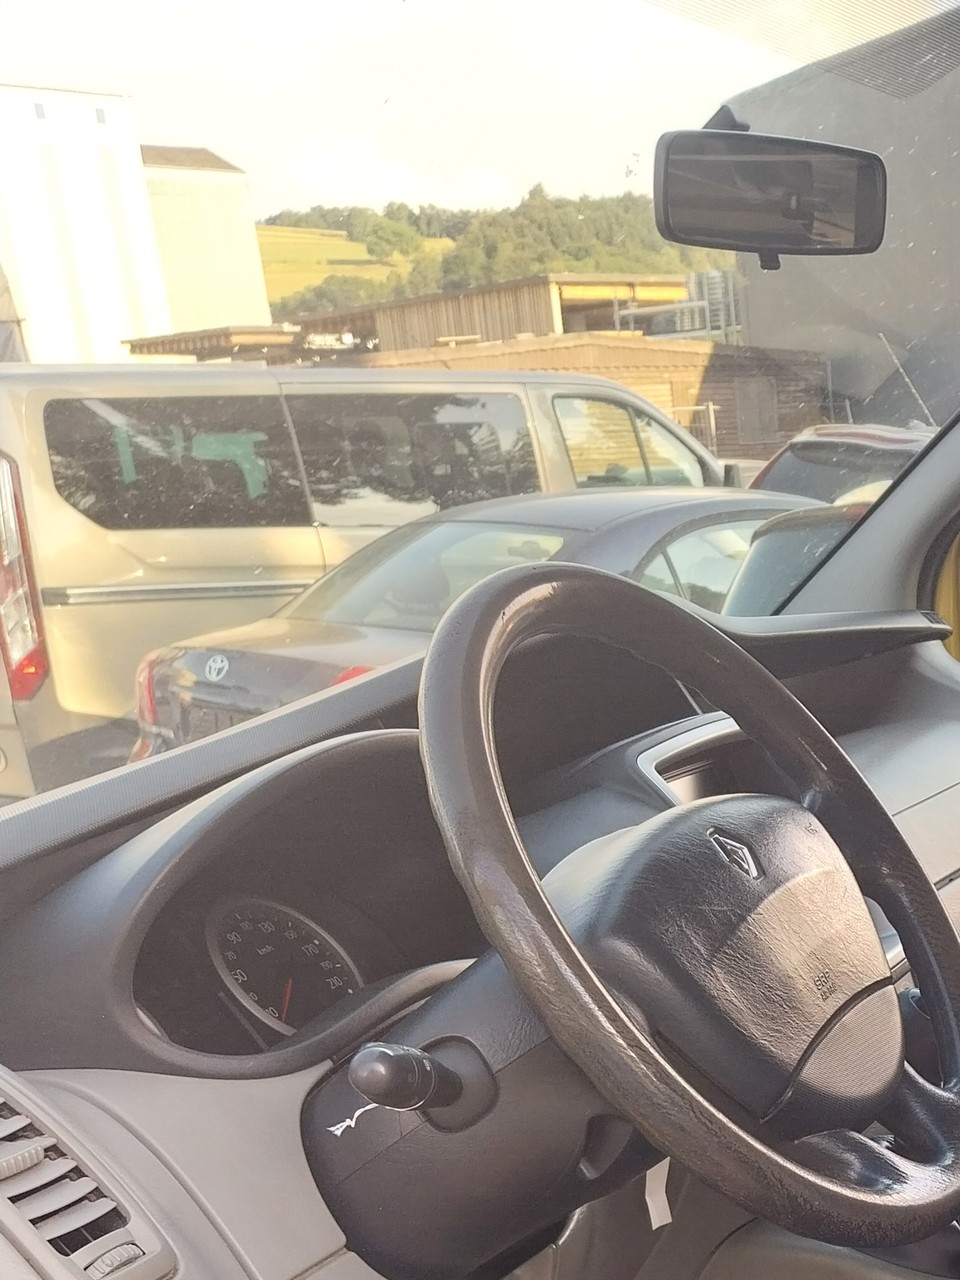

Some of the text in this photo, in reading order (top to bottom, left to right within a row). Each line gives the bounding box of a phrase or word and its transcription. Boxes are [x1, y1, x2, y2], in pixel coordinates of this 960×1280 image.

[226, 931, 242, 944] 90
[301, 943, 319, 956] 170
[325, 975, 343, 990] 210
